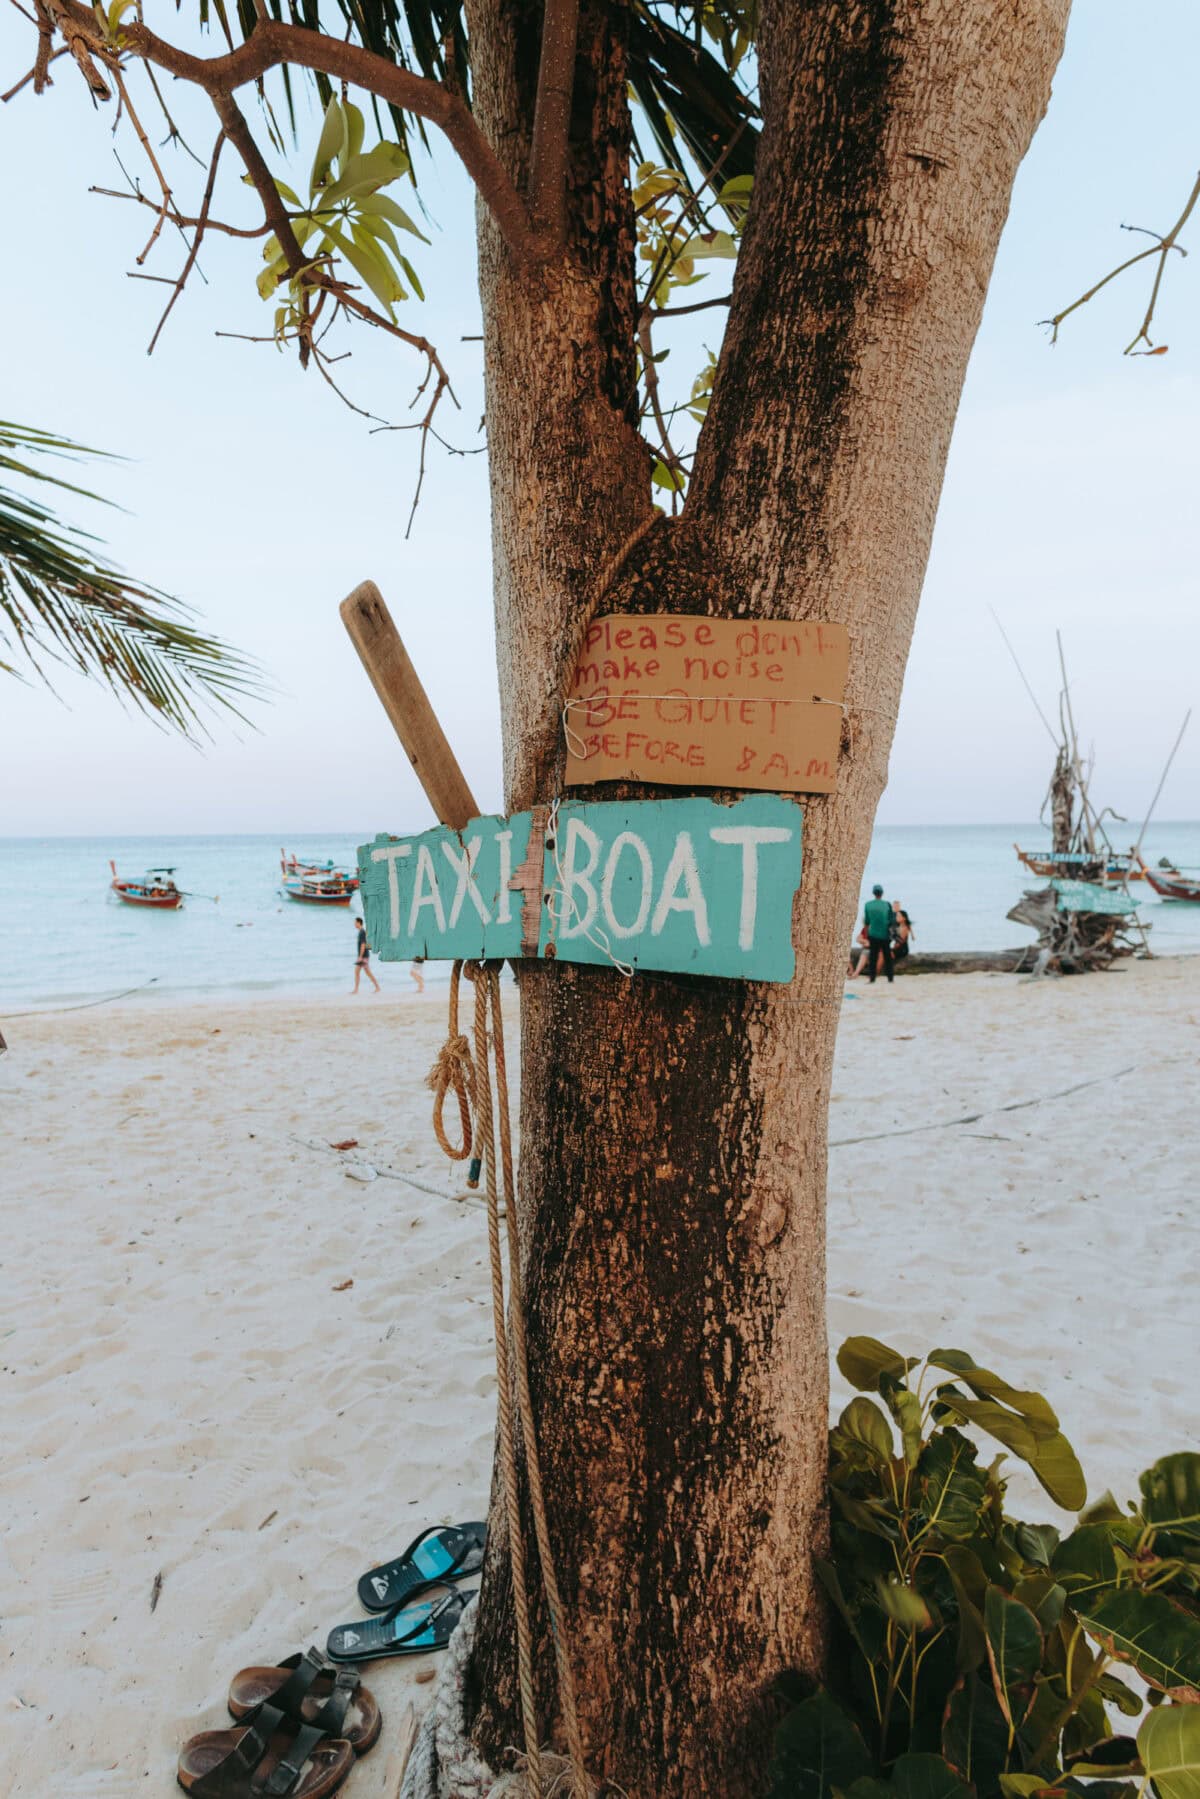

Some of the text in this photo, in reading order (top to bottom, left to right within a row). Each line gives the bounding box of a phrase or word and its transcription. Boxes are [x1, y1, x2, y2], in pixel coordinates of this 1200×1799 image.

[585, 622, 837, 657] Please don't
[574, 656, 785, 688] make noise
[586, 686, 640, 728] BE
[583, 732, 705, 767] BEFORE
[736, 746, 757, 772] 8
[371, 817, 794, 952] TAXI BOAT
